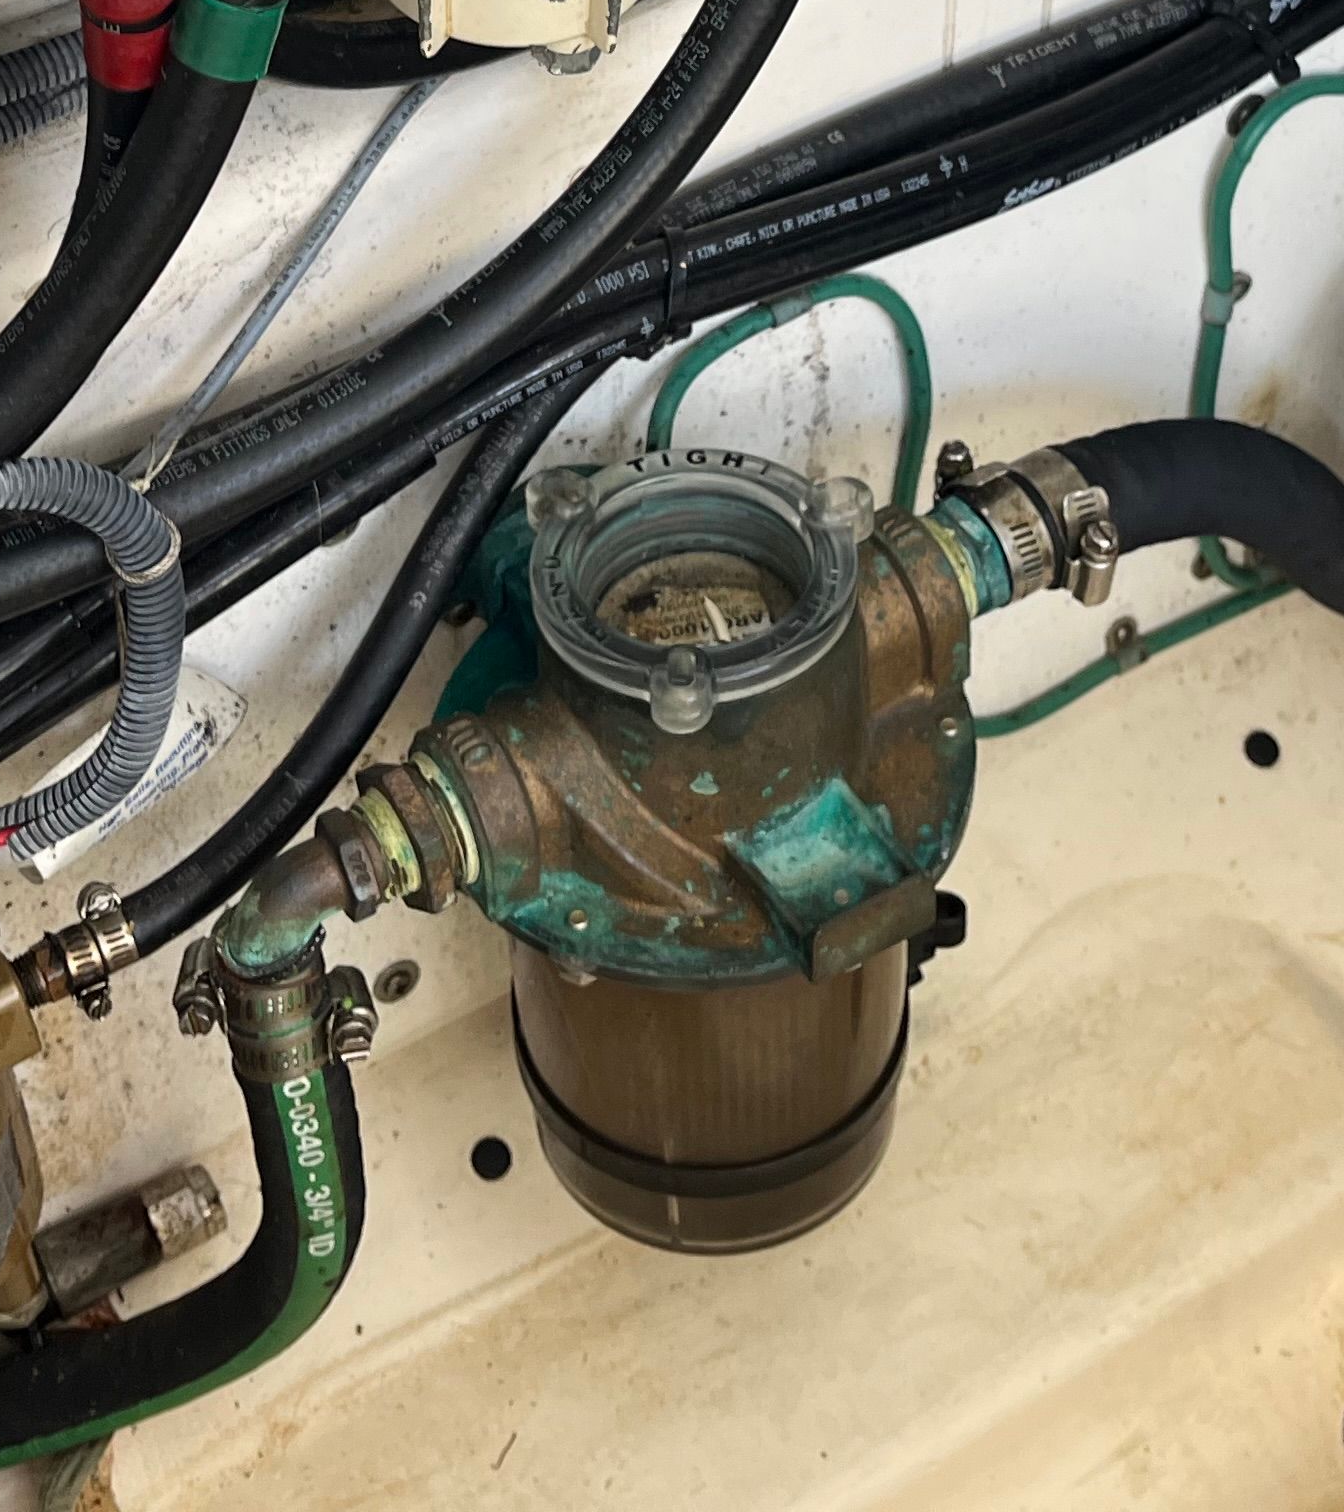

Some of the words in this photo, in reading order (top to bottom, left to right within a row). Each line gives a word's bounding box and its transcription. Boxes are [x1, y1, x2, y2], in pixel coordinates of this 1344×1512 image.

[1120, 21, 1144, 39] TYPE
[1005, 31, 1078, 69] TRIDENT
[400, 90, 424, 119] LAPP
[364, 125, 397, 166] KABEL
[564, 189, 592, 217] TYPE
[590, 145, 633, 194] ACCEPTED
[659, 81, 684, 111] H-24
[679, 70, 691, 82] &
[685, 41, 710, 71] H-33
[595, 270, 625, 295] 1000
[627, 259, 650, 284] PSI
[758, 224, 781, 241] NICK
[783, 218, 795, 233] OR
[797, 202, 838, 228] PUNCTURE
[860, 192, 873, 208] IN
[467, 417, 480, 430] OR
[481, 391, 523, 422] PUNCTURE
[552, 371, 564, 385] IN
[2, 524, 37, 548] WITH
[212, 423, 272, 462] FITTINGS
[272, 408, 305, 433] ONLY
[627, 451, 770, 476] TIGHT
[307, 1233, 336, 1258] ID
